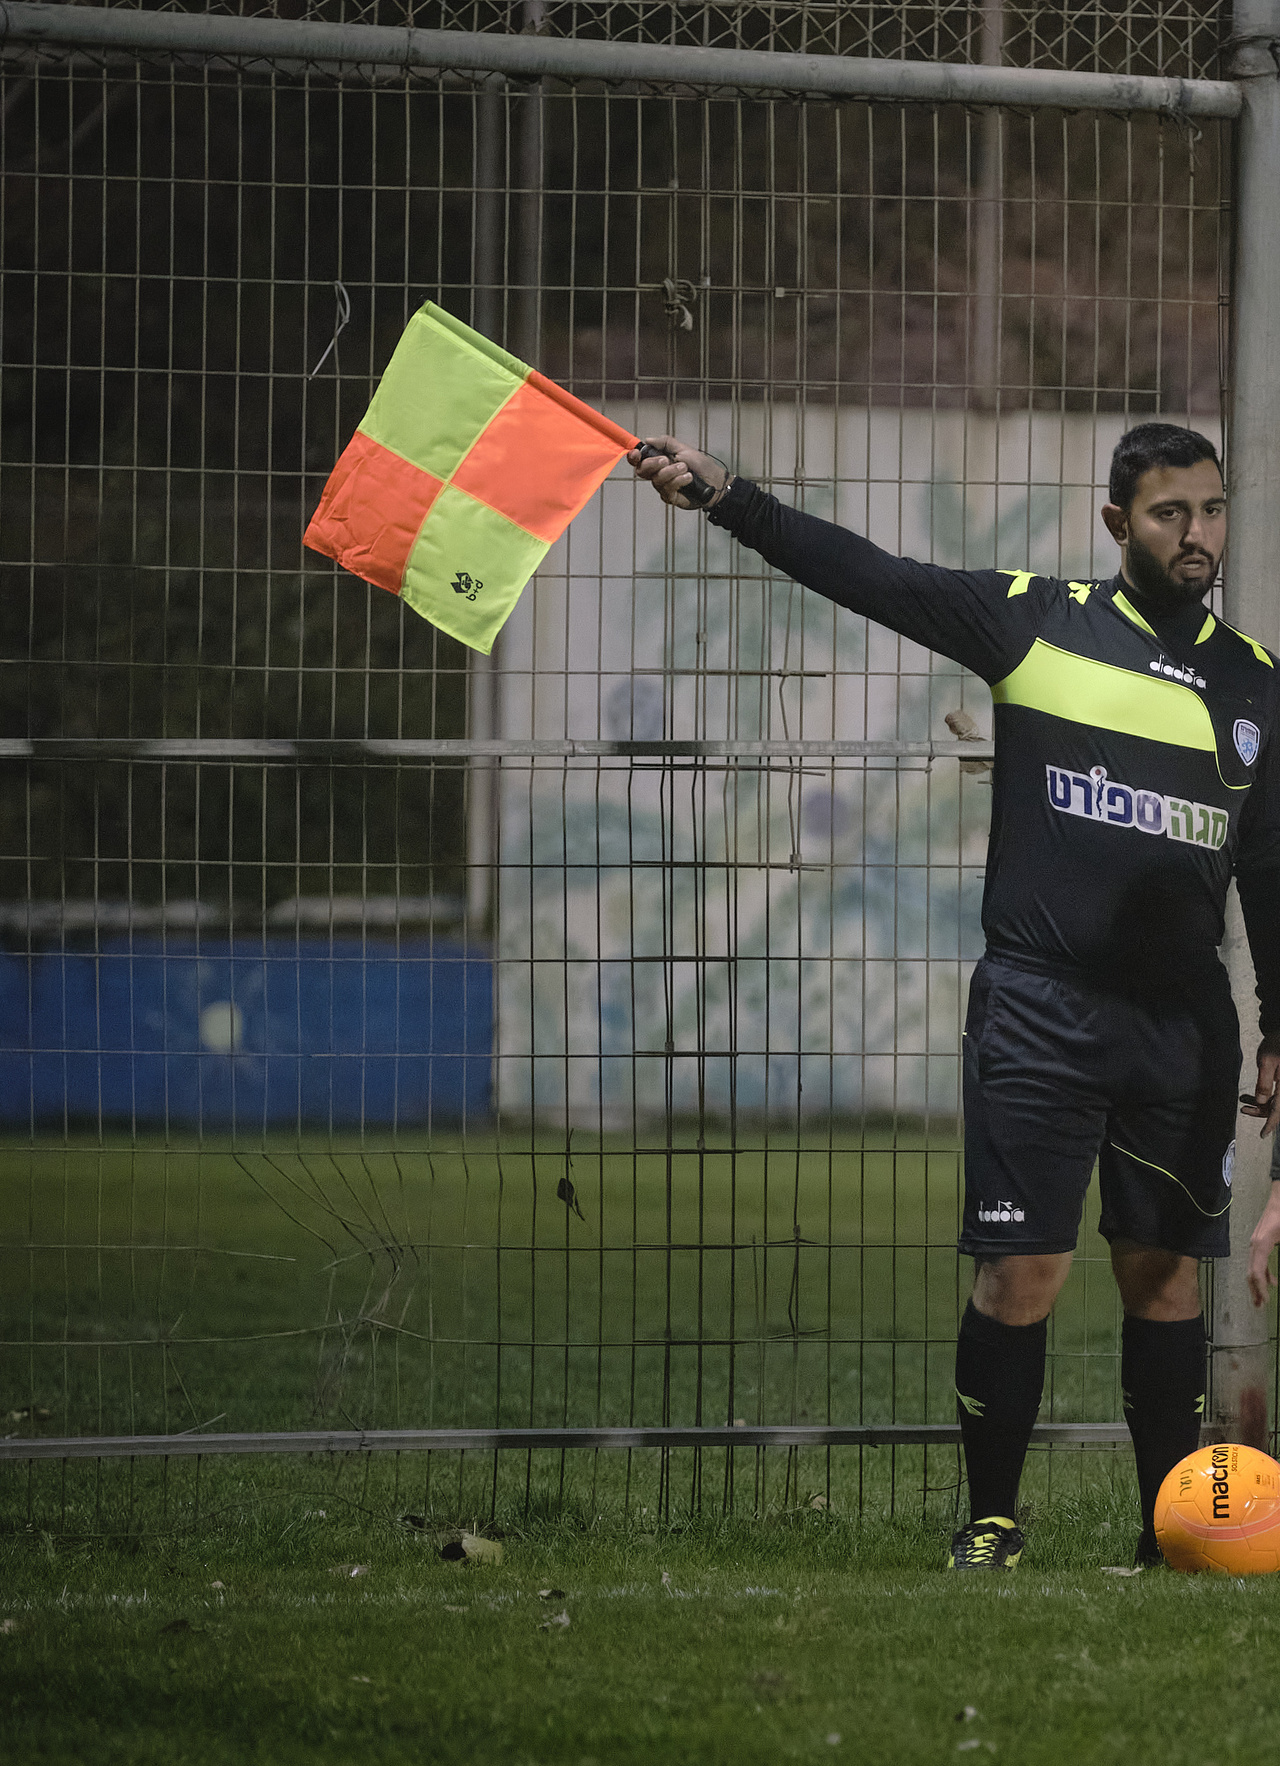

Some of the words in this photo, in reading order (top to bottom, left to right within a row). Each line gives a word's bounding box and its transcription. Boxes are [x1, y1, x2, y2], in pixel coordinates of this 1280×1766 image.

[1149, 653, 1207, 690] diadora
[978, 1199, 1025, 1222] diadora
[1211, 1446, 1230, 1520] macron
